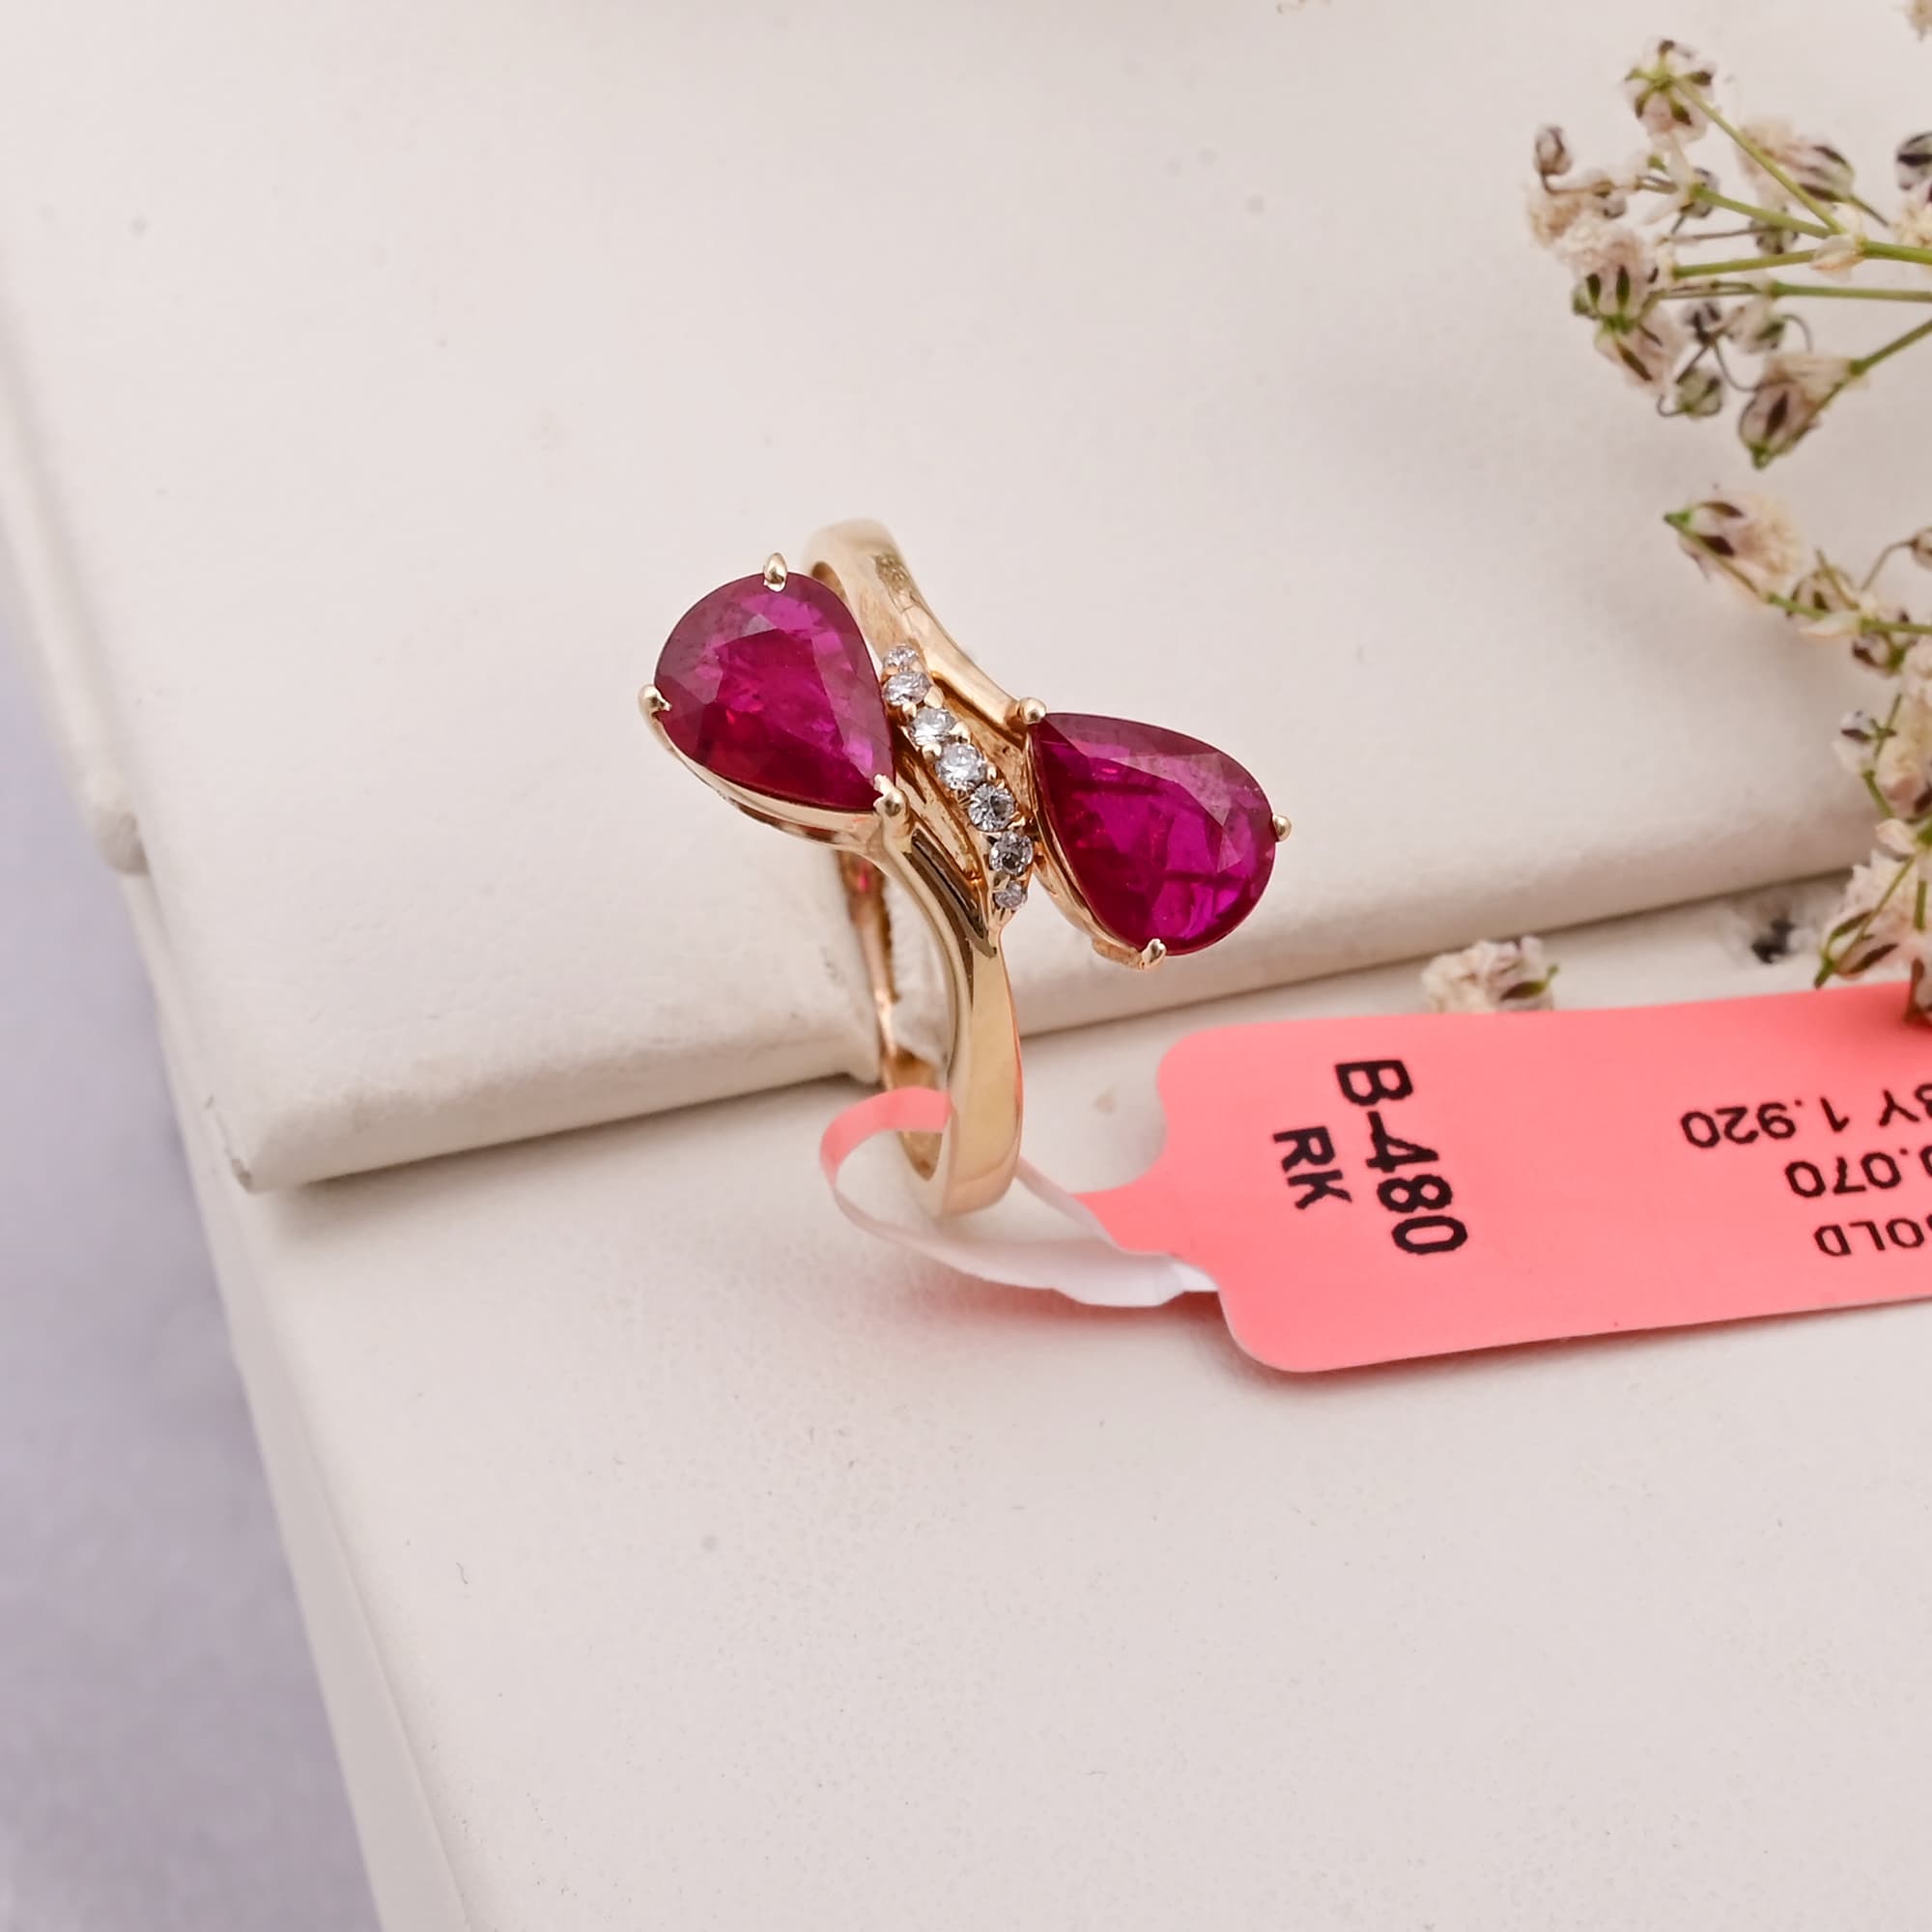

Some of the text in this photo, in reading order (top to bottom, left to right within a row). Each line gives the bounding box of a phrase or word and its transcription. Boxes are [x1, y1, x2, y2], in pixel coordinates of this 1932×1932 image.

[1680, 1097, 1850, 1149] 1.920
[1272, 1125, 1352, 1210] RK
[1334, 1059, 1469, 1256] B-480
[1813, 1213, 1932, 1257] OLD
